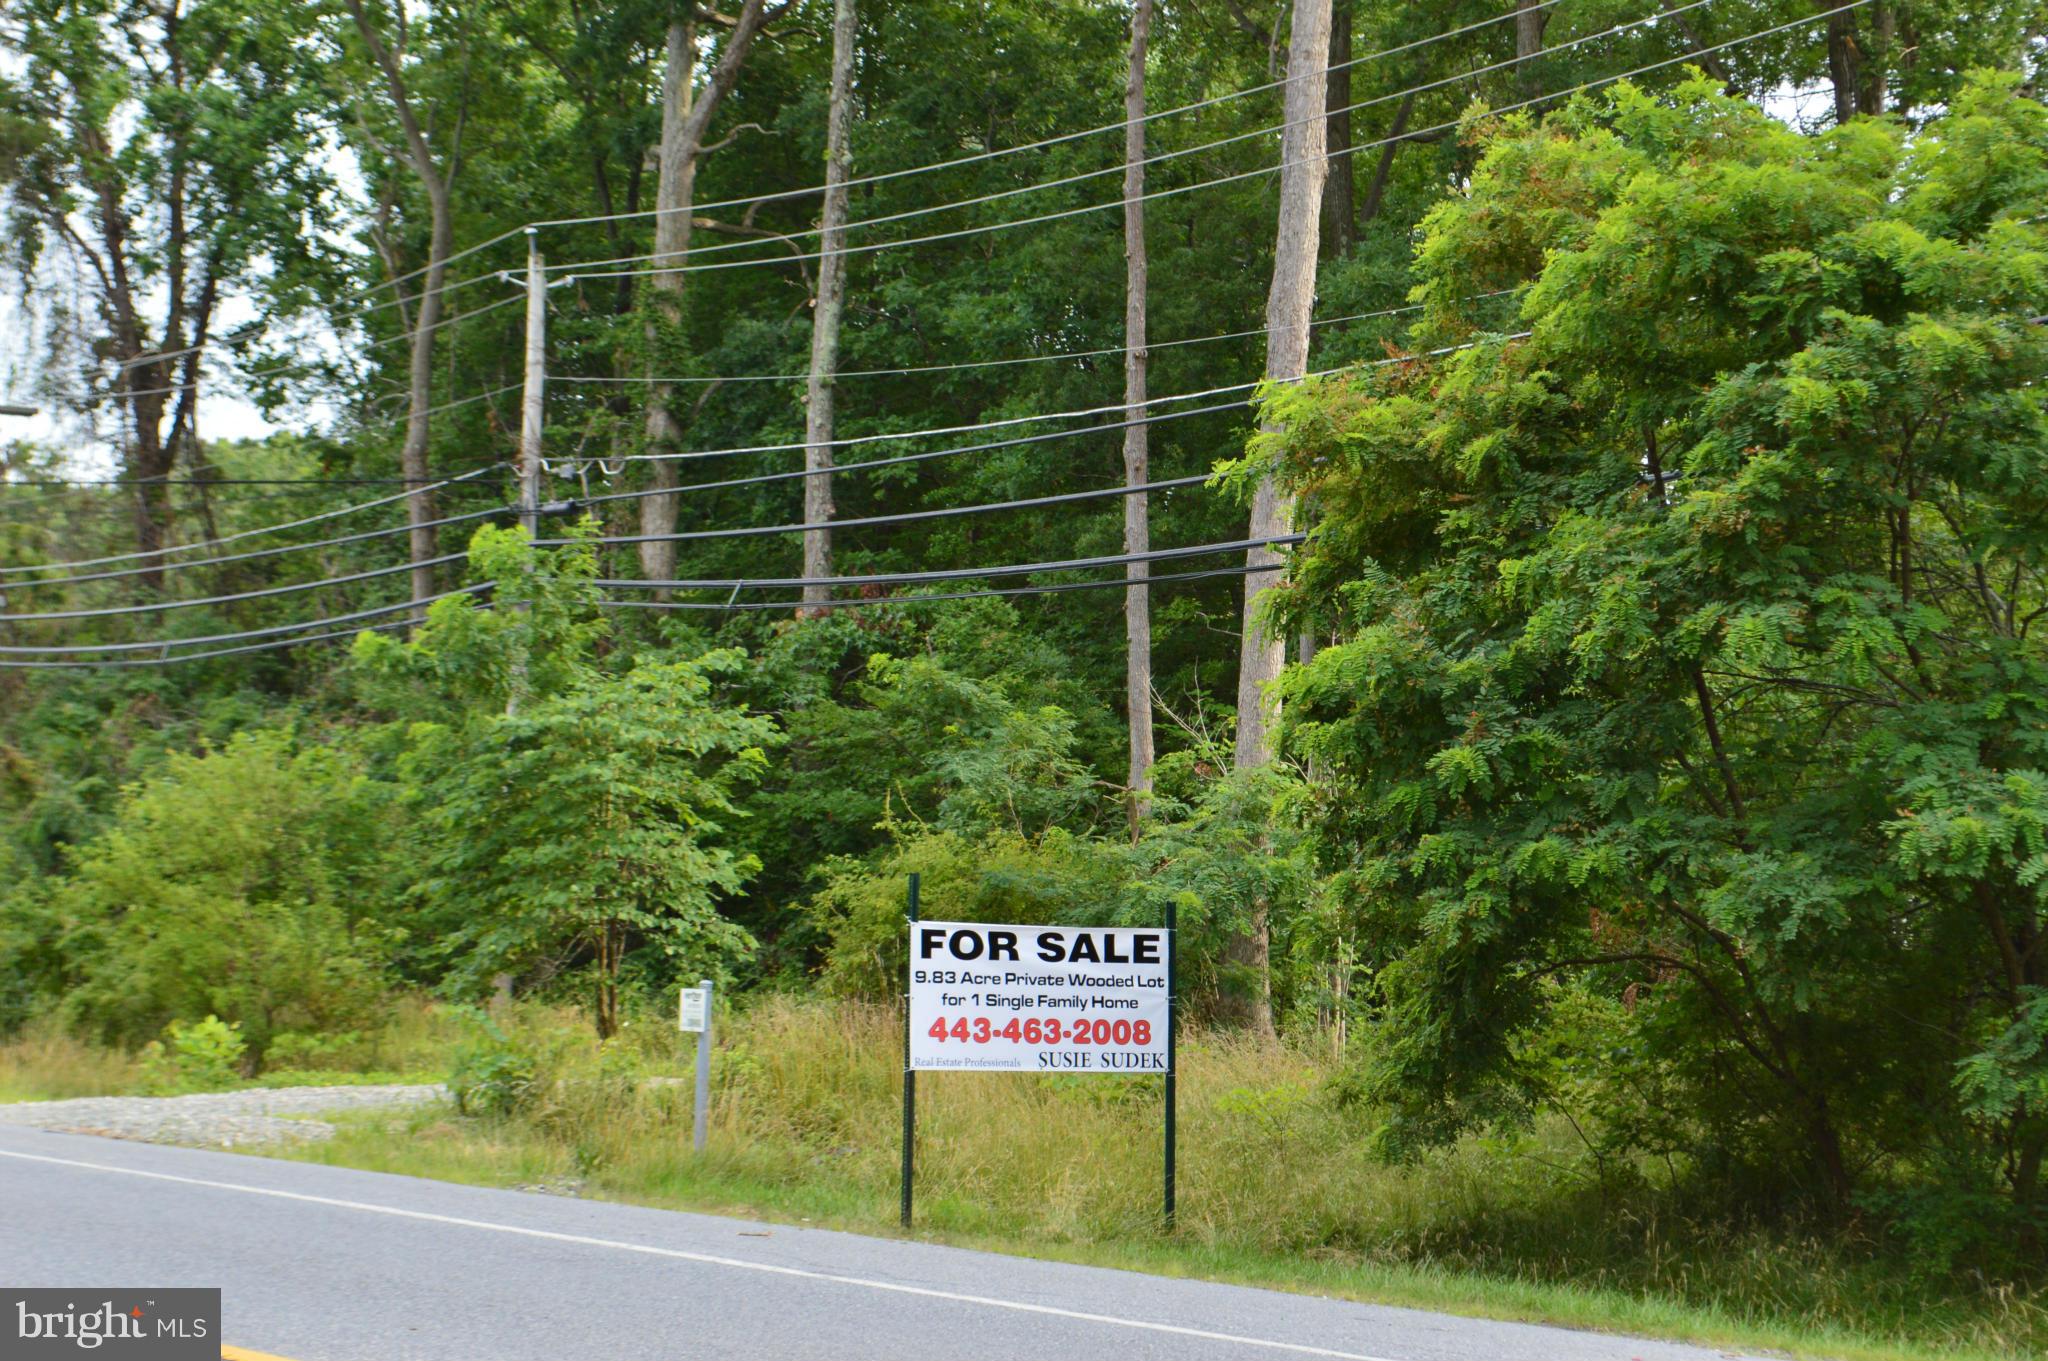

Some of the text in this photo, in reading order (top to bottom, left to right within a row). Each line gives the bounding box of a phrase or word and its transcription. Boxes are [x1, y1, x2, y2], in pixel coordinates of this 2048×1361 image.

[921, 929, 1161, 964] FOR SALE
[915, 971, 1165, 988] 9.83 Acre Private Wooded Lot
[942, 993, 1138, 1011] for 1 Single Family Home
[928, 1016, 1151, 1045] 443-463-2008
[914, 1057, 1021, 1068] Real Estate Professionals
[1038, 1051, 1165, 1069] SUSIE SUDEK
